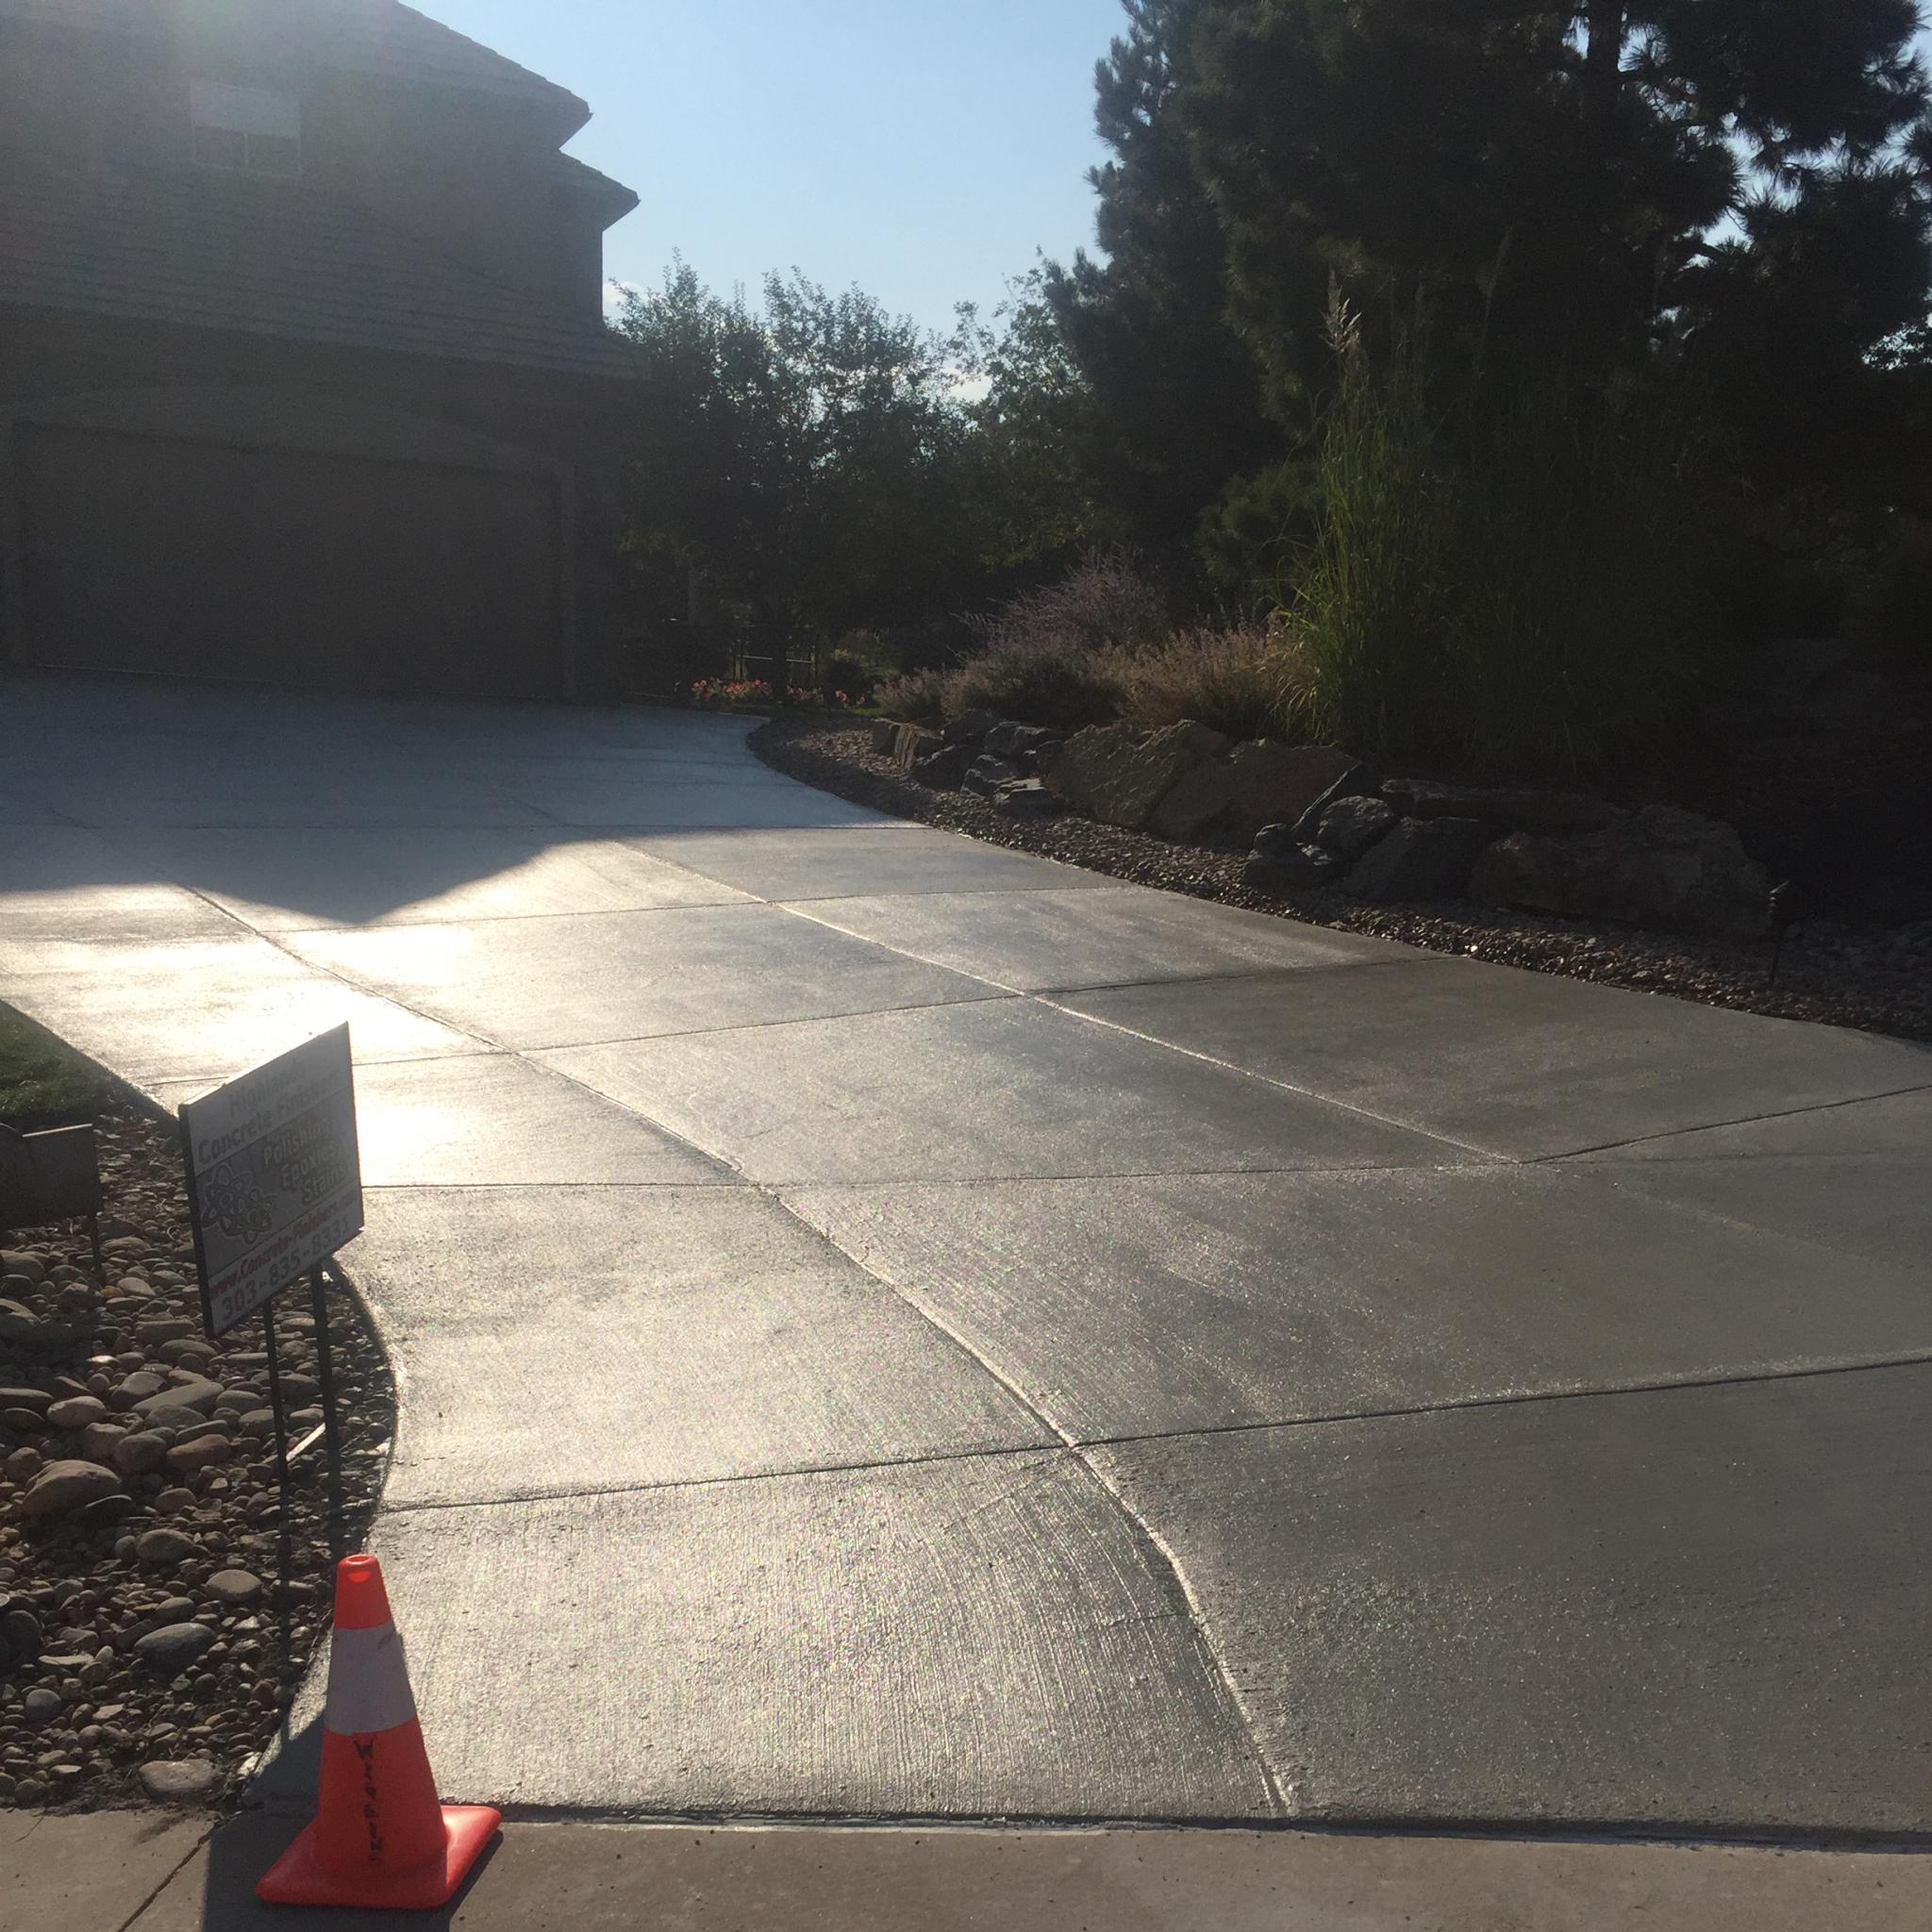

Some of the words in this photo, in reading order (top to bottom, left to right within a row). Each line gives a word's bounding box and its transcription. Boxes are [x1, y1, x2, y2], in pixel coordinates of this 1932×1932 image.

[198, 1108, 272, 1164] Concrete
[263, 1116, 332, 1171] Polishing
[281, 1136, 337, 1189] Epoxies
[303, 1159, 347, 1204] Stains
